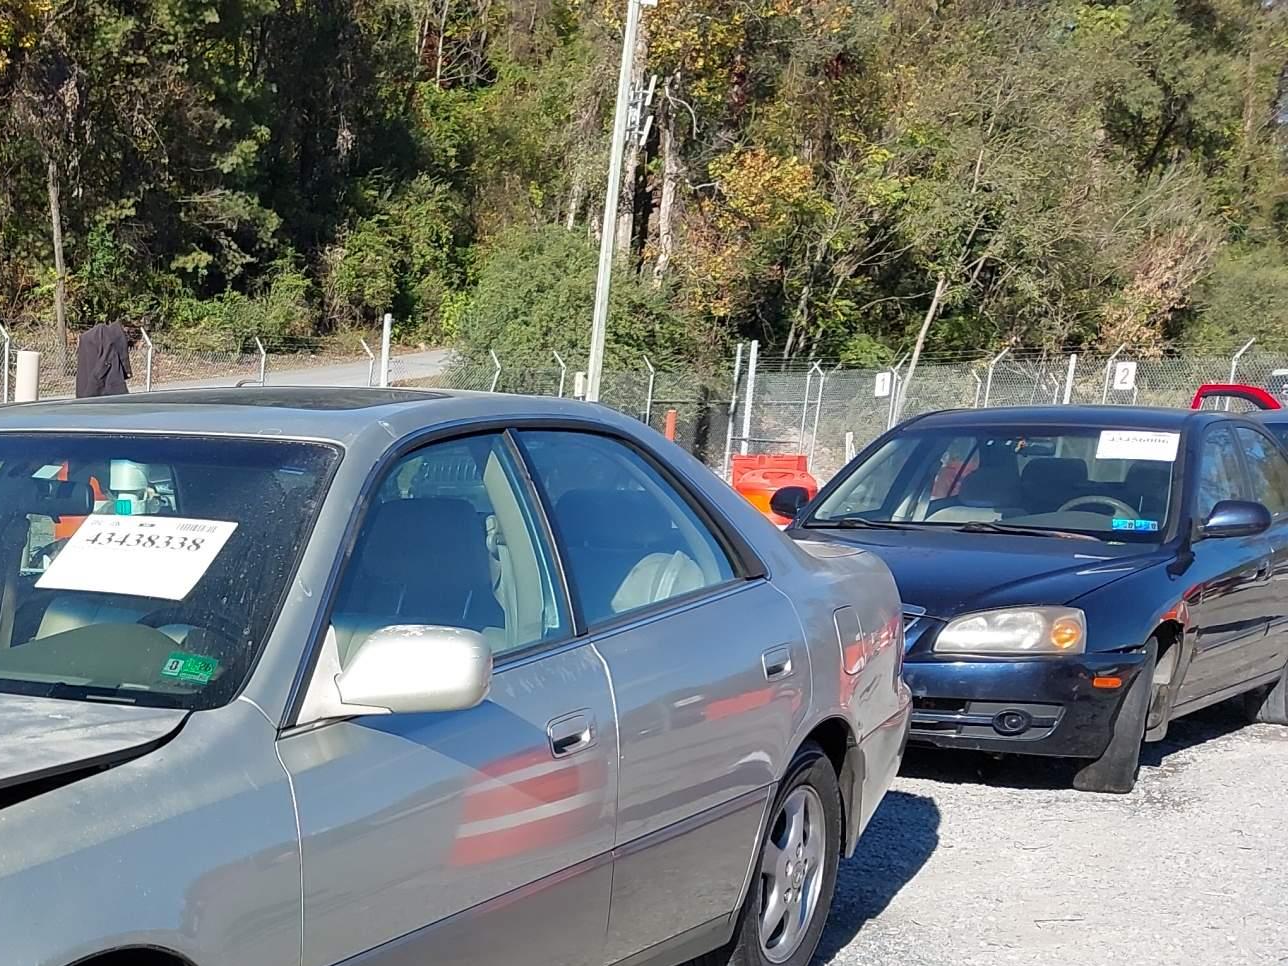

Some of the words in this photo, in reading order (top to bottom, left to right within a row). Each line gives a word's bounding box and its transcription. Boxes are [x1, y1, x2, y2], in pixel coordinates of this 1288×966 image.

[1119, 367, 1130, 384] 2
[880, 376, 886, 393] 1
[86, 532, 206, 551] 43438338
